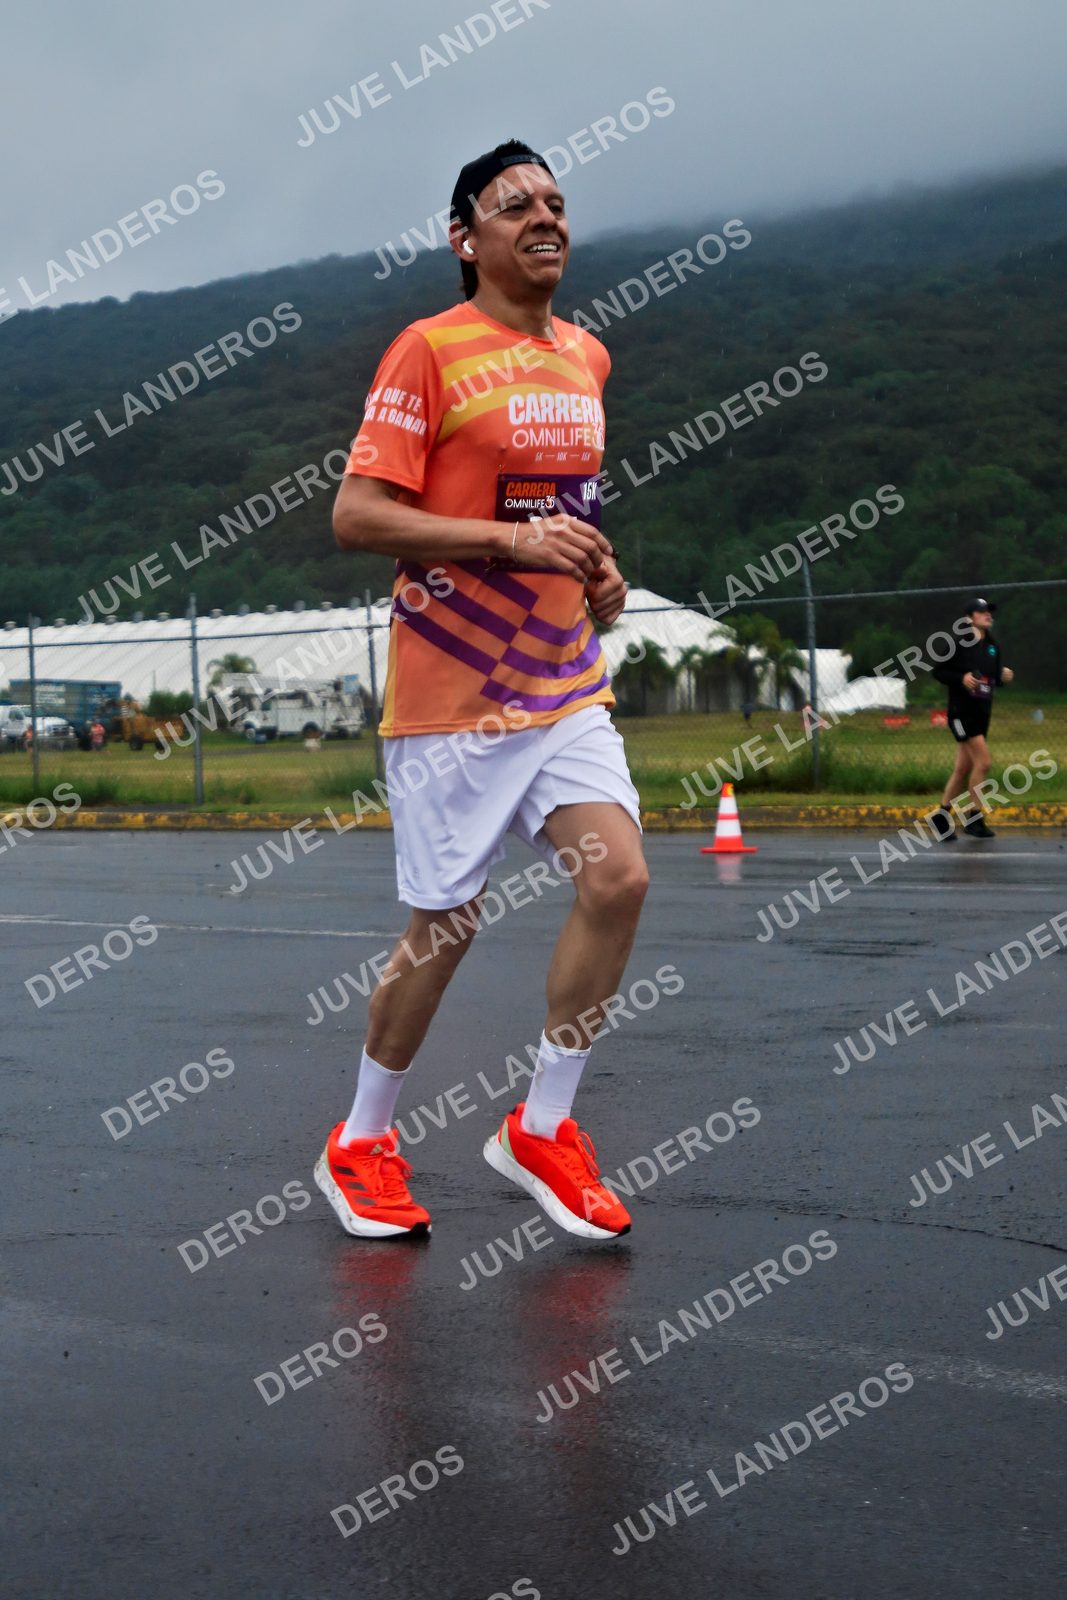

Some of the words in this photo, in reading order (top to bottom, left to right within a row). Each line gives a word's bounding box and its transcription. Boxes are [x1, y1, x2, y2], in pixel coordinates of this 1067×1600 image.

[382, 387, 407, 406] QUE
[407, 394, 423, 412] TE
[508, 391, 604, 426] CARRERA
[377, 406, 388, 422] A
[506, 480, 557, 498] CARRERA
[583, 482, 598, 501] 15K
